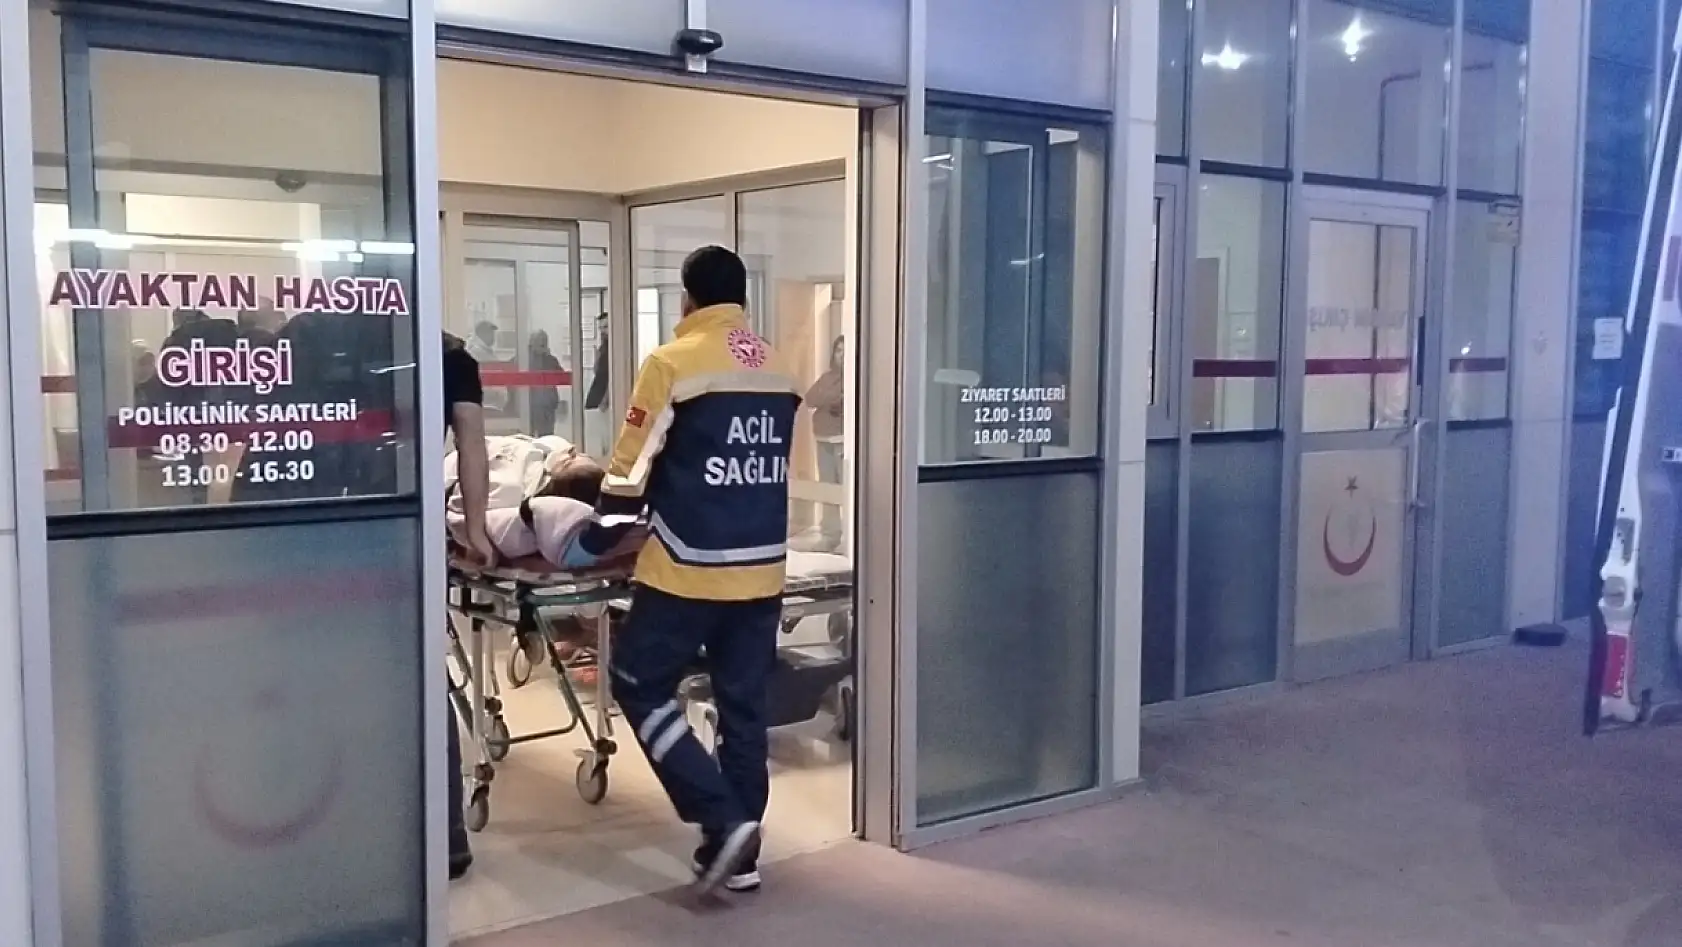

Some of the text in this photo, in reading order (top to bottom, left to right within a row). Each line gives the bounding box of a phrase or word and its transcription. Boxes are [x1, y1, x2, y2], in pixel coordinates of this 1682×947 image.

[50, 269, 410, 315] AYAKTAN HASTA
[159, 339, 293, 393] GİRİŞİ
[960, 384, 1066, 402] ZİYARET SAATLERİ
[118, 398, 358, 426] POLİKLİNİK SAATLERİ
[974, 407, 1009, 423] 12.00
[1018, 406, 1052, 422] 13.00
[727, 409, 782, 444] ACİL
[974, 429, 1008, 444] 18.00
[1017, 428, 1052, 443] 20.00
[159, 432, 228, 456] 08.30
[249, 430, 313, 453] 12.00
[161, 463, 229, 487] 13.00
[249, 460, 314, 483] 16.30
